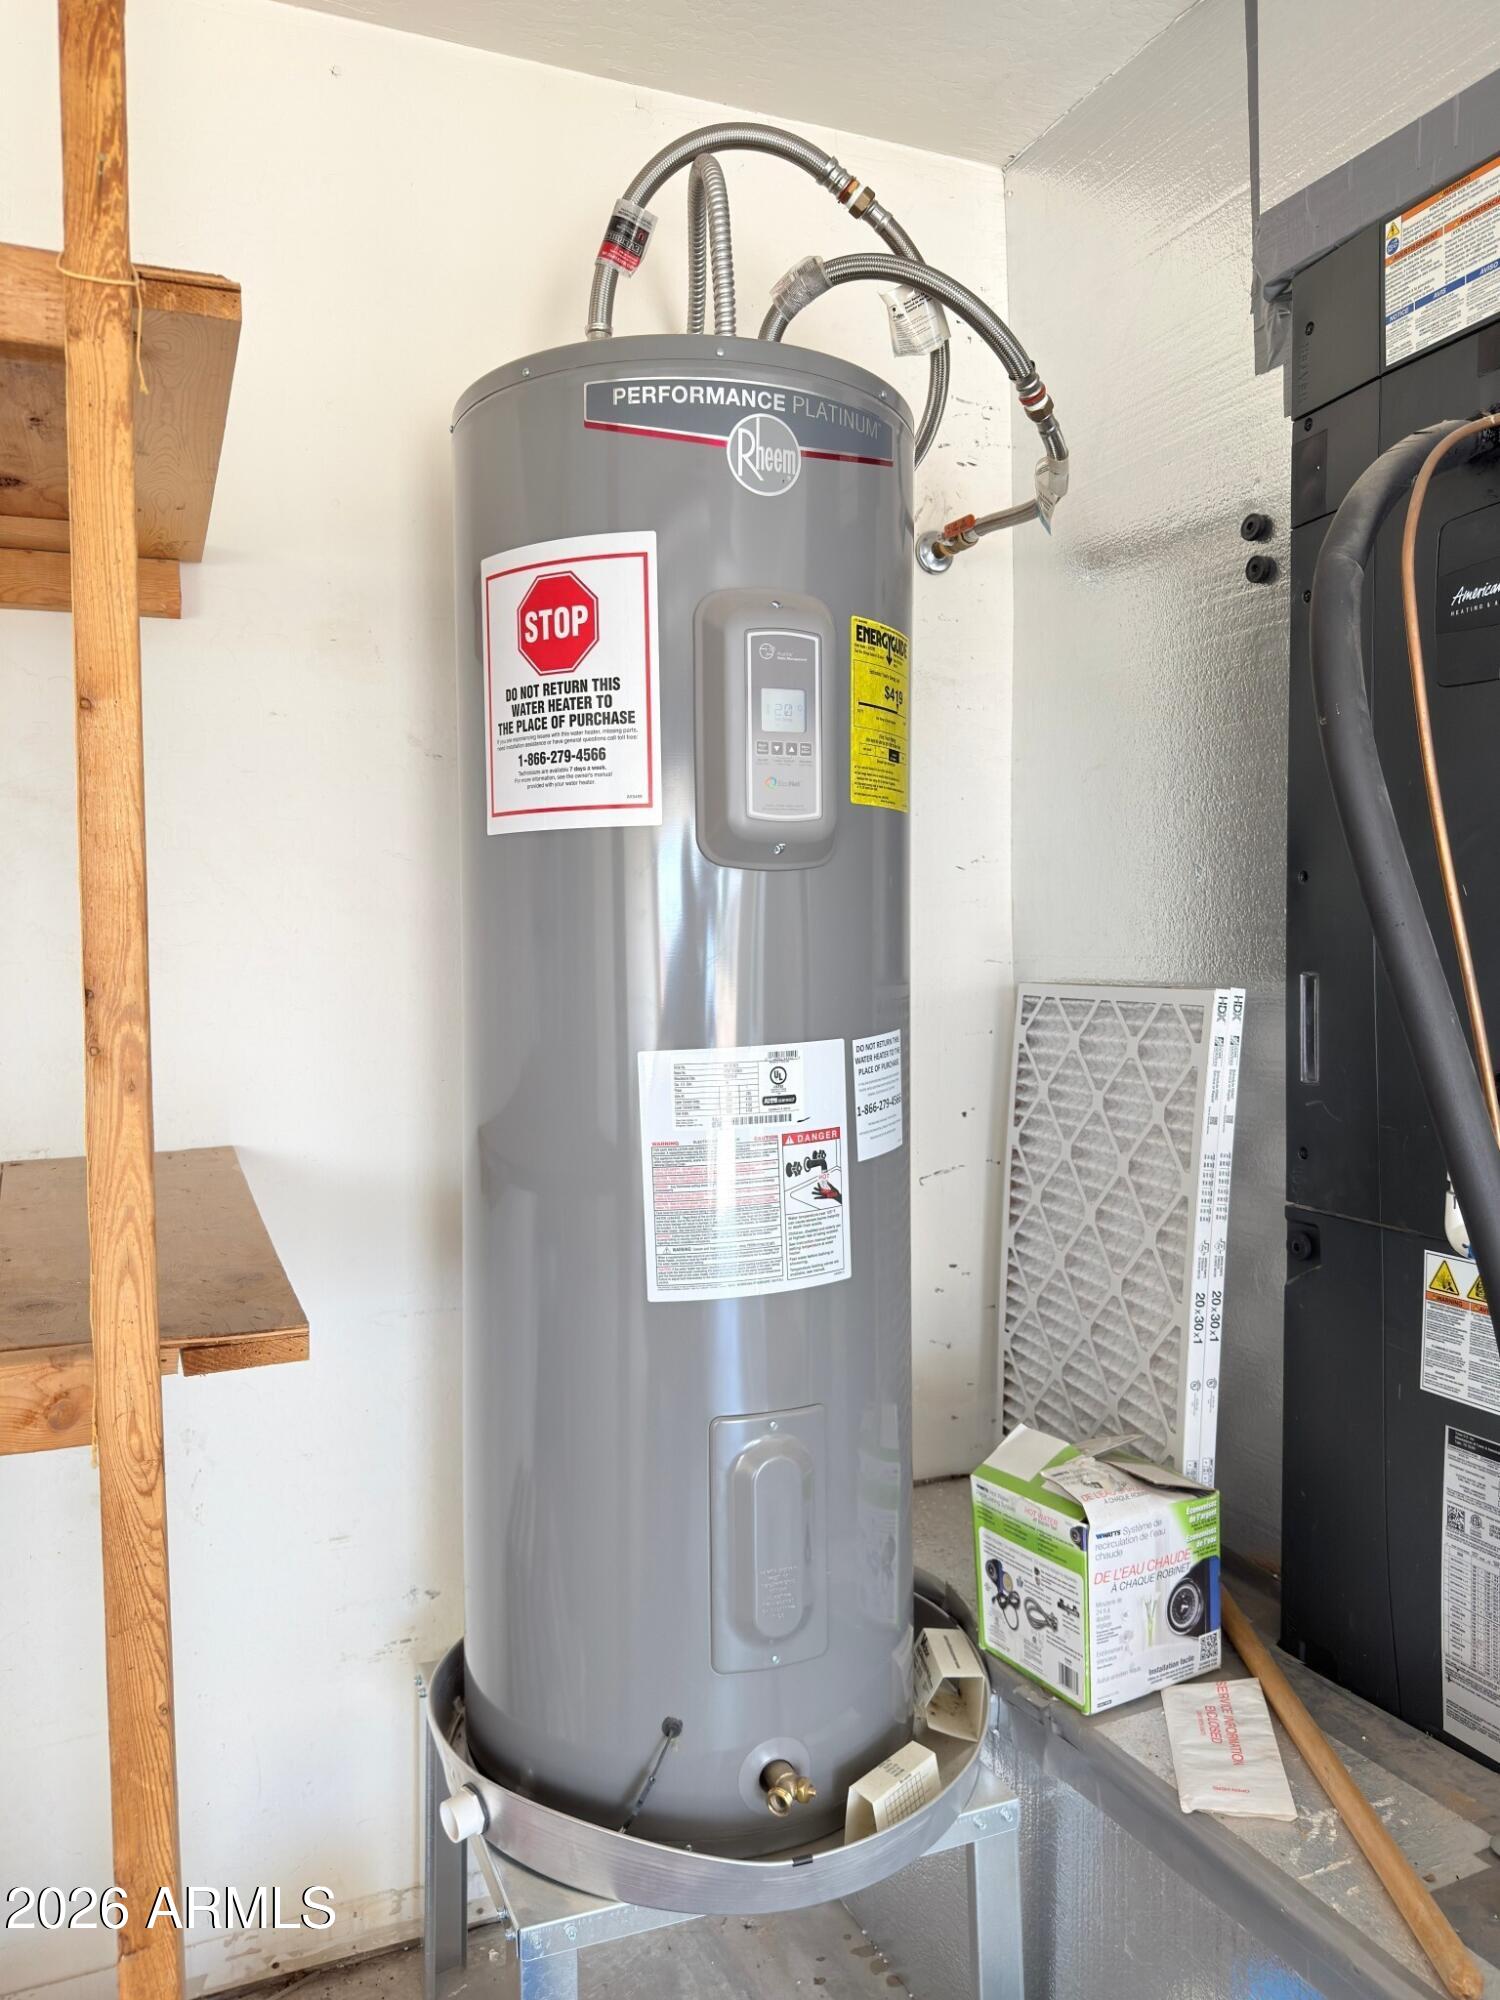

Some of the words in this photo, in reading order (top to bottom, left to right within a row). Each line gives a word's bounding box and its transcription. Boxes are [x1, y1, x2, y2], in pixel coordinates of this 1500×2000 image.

[612, 385, 786, 412] PERFORMANCE
[737, 417, 796, 481] Rheem
[524, 604, 589, 643] STOP
[505, 687, 518, 702] DO
[520, 684, 540, 700] NOT
[543, 679, 588, 696] RETURN
[592, 677, 621, 691] THIS
[511, 700, 545, 717] WATER
[548, 695, 592, 713] HEATER
[596, 694, 613, 708] TO
[498, 721, 514, 736] THE
[516, 716, 547, 733] PLACE
[551, 715, 566, 729] OF
[569, 710, 636, 727] PURCHASE
[518, 746, 607, 767] 1-866-279-4566
[1216, 996, 1228, 1023] HDX
[1232, 995, 1244, 1021] HDX
[854, 1054, 873, 1065] WATER
[874, 1050, 889, 1061] HEATER
[855, 1044, 864, 1053] DO
[865, 1042, 876, 1051] NOT
[773, 1070, 783, 1081] UL
[858, 1065, 874, 1075] PLACE
[875, 1063, 881, 1072] OF
[797, 1129, 838, 1143] DANGER
[1096, 1530, 1121, 1539] WATTS
[1123, 1522, 1152, 1536] Système
[1153, 1519, 1162, 1527] de
[1095, 1535, 1138, 1551] recirculation
[1139, 1532, 1148, 1541] de
[1094, 1570, 1111, 1585] DE
[1113, 1561, 1146, 1581] L'EAU
[1146, 1548, 1191, 1572] CHAUDE
[1095, 1549, 1123, 1561] chaude
[1119, 1572, 1156, 1591] CHAQUE
[1156, 1562, 1191, 1580] ROBINET
[1149, 1660, 1180, 1675] Installation
[1216, 1681, 1233, 1714] SERVICE
[1223, 1715, 1245, 1766] INFORMATION
